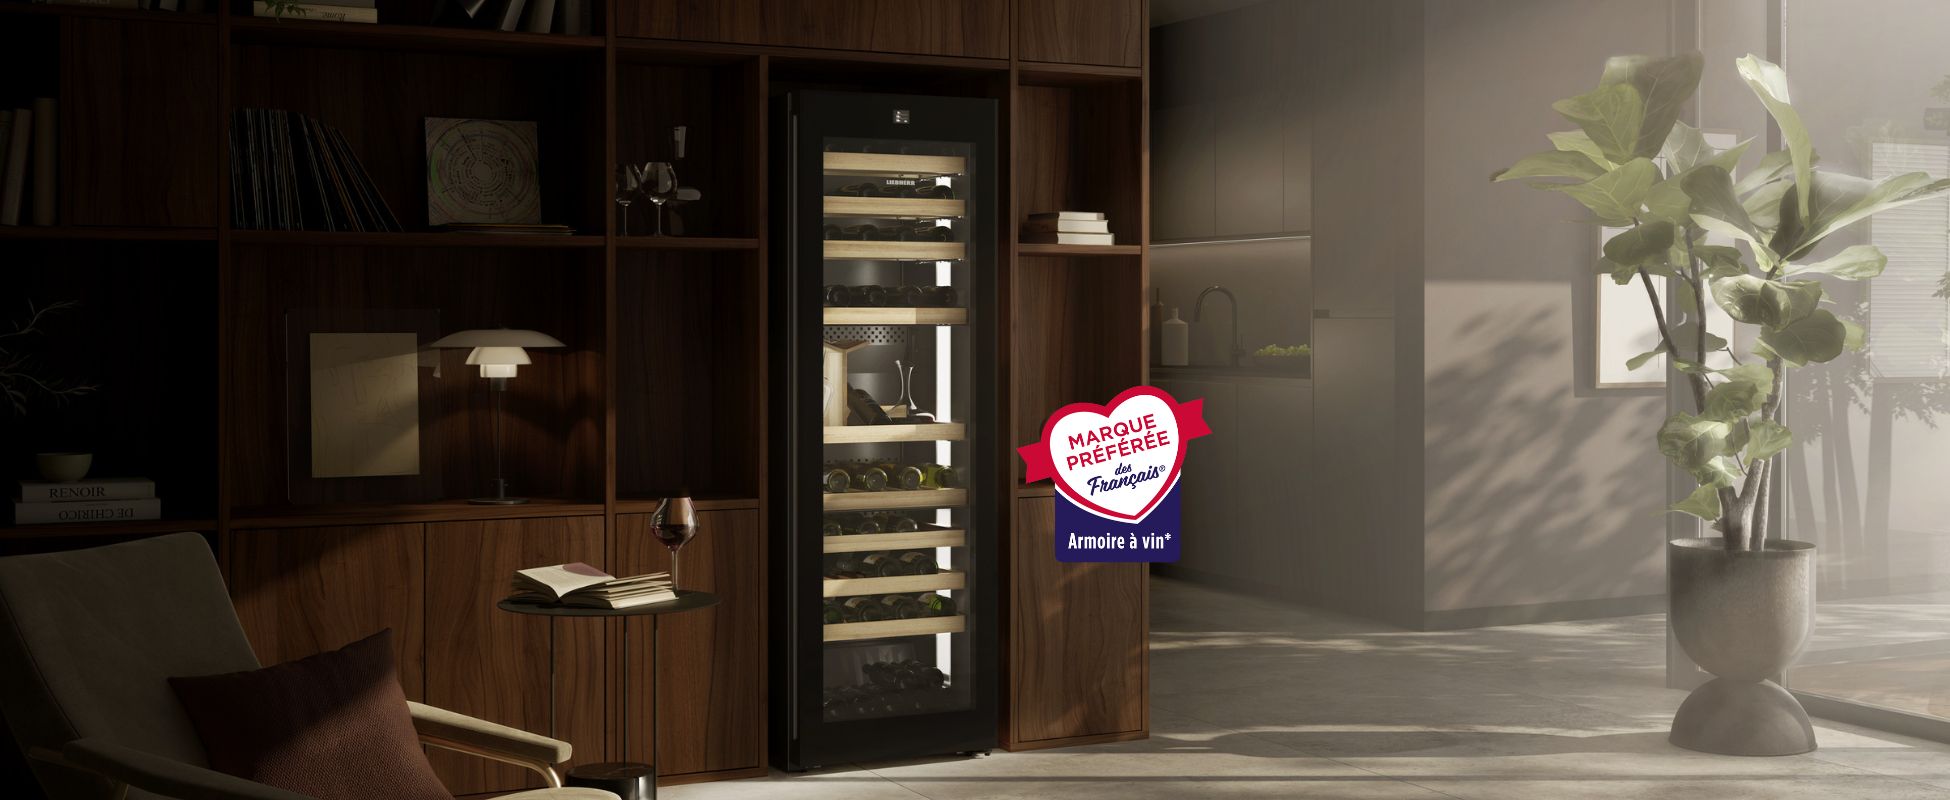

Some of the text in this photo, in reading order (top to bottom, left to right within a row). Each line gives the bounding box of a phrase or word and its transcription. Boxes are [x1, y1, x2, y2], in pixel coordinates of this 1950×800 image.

[49, 487, 106, 498] RENOIR
[58, 508, 134, 520] DE CHIRICO
